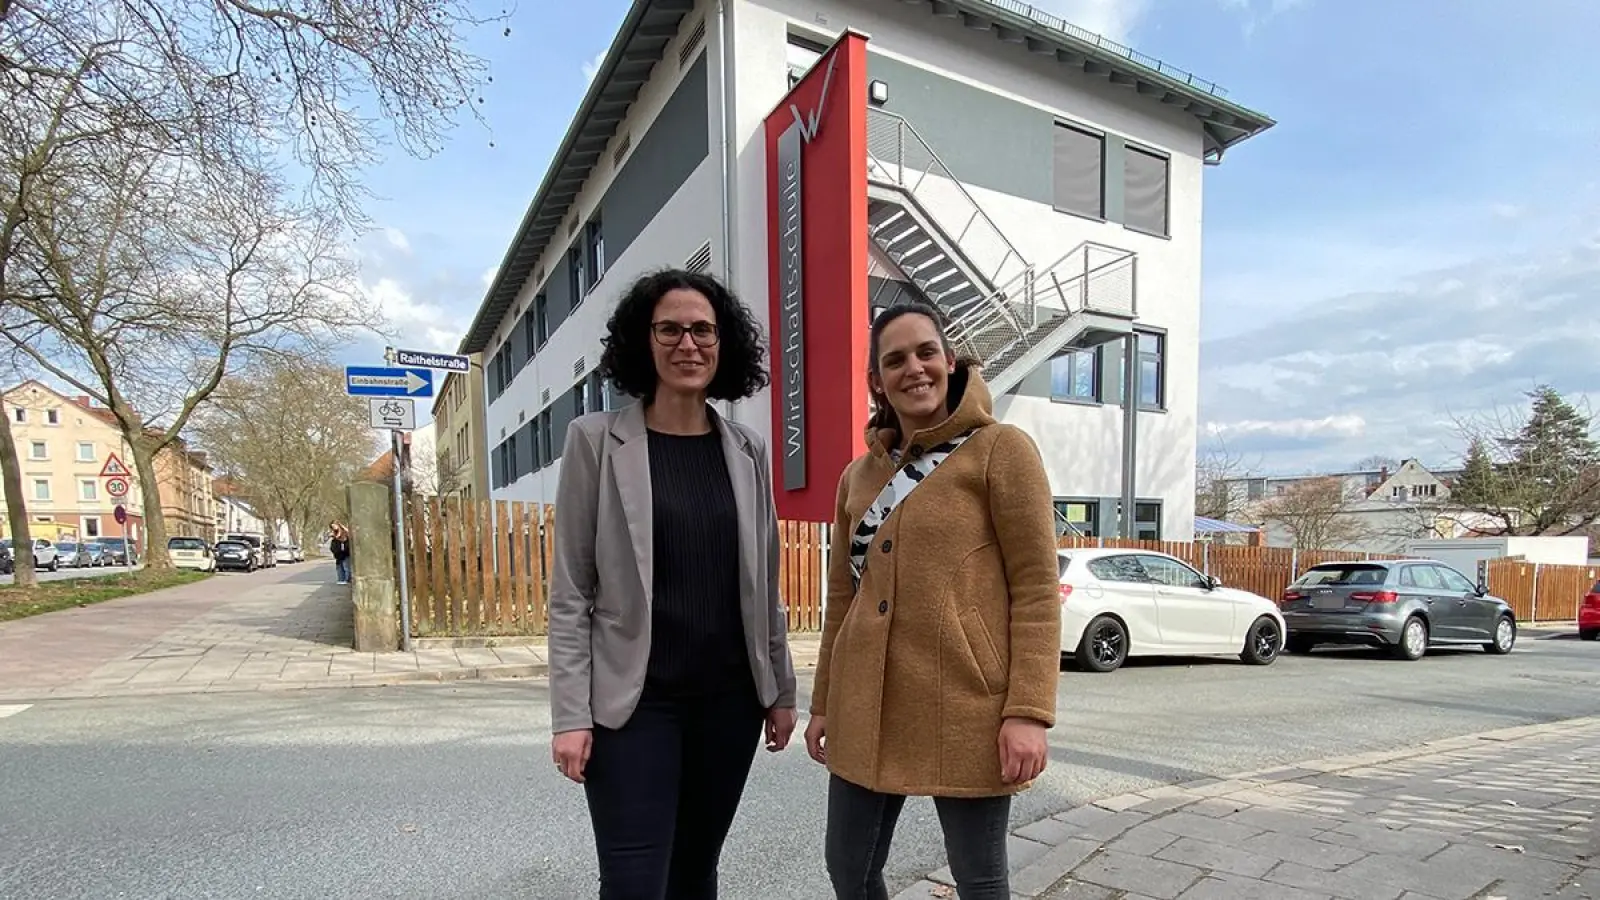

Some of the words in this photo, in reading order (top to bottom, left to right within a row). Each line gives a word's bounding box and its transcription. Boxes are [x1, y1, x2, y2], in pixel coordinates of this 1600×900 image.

[783, 160, 801, 457] Wirtschaftsschule
[400, 353, 466, 369] Raithelstraße
[110, 482, 125, 493] 30
